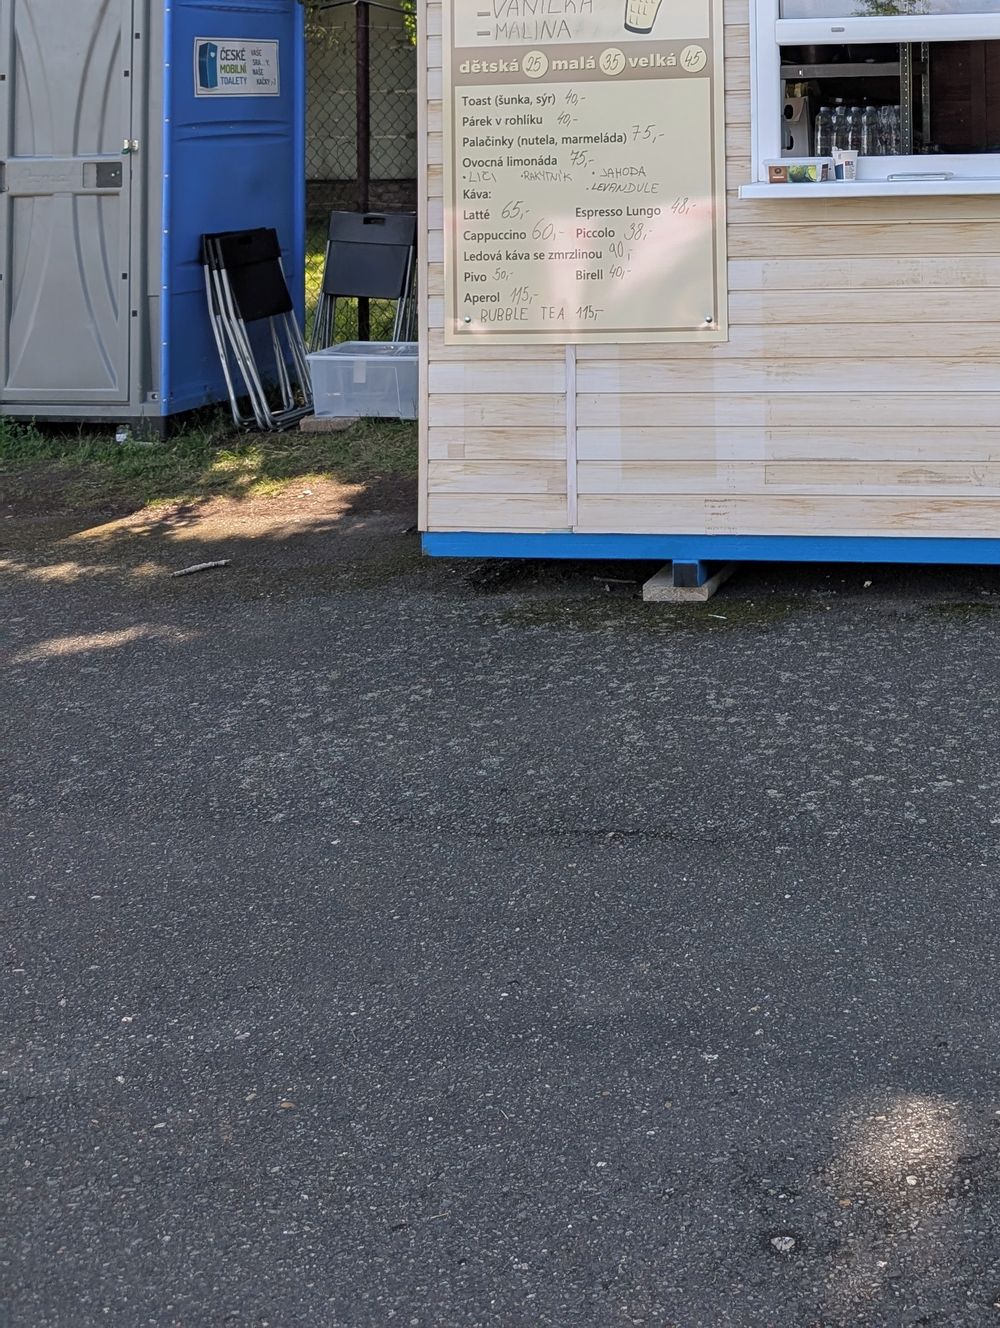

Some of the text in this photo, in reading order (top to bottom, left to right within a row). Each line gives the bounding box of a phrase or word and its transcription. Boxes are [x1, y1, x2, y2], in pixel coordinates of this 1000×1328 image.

[220, 47, 246, 61] ČESKÉ
[459, 58, 519, 74] dětská
[552, 55, 596, 71] malá
[603, 54, 620, 71] 35
[628, 51, 677, 68] velká
[685, 49, 702, 66] 45
[220, 63, 247, 74] MOBILNÍ
[220, 77, 248, 85] TOALETY
[462, 96, 491, 106] Toast
[495, 94, 532, 107] (šunka,
[536, 93, 556, 107] sýr)
[462, 116, 492, 127] Párek
[505, 114, 543, 125] rohlíku
[462, 136, 514, 149] Palačinky
[517, 134, 558, 147] (nutela,
[561, 132, 627, 144] marmeláda)
[462, 156, 504, 167] Ovocná
[507, 155, 558, 167] limonáda
[463, 189, 492, 199] Káva:
[463, 209, 490, 220] Latté
[576, 207, 623, 220] Espresso
[626, 206, 662, 218] Lungo
[463, 230, 527, 243] Cappuccino
[576, 227, 616, 238] Piccolo
[464, 250, 502, 262] Ledová
[505, 250, 530, 260] káva
[548, 249, 603, 260] zmrzlinou
[464, 272, 487, 282] Pivo
[575, 269, 603, 280] Birell
[464, 292, 500, 305] Aperol
[541, 306, 565, 320] TEA
